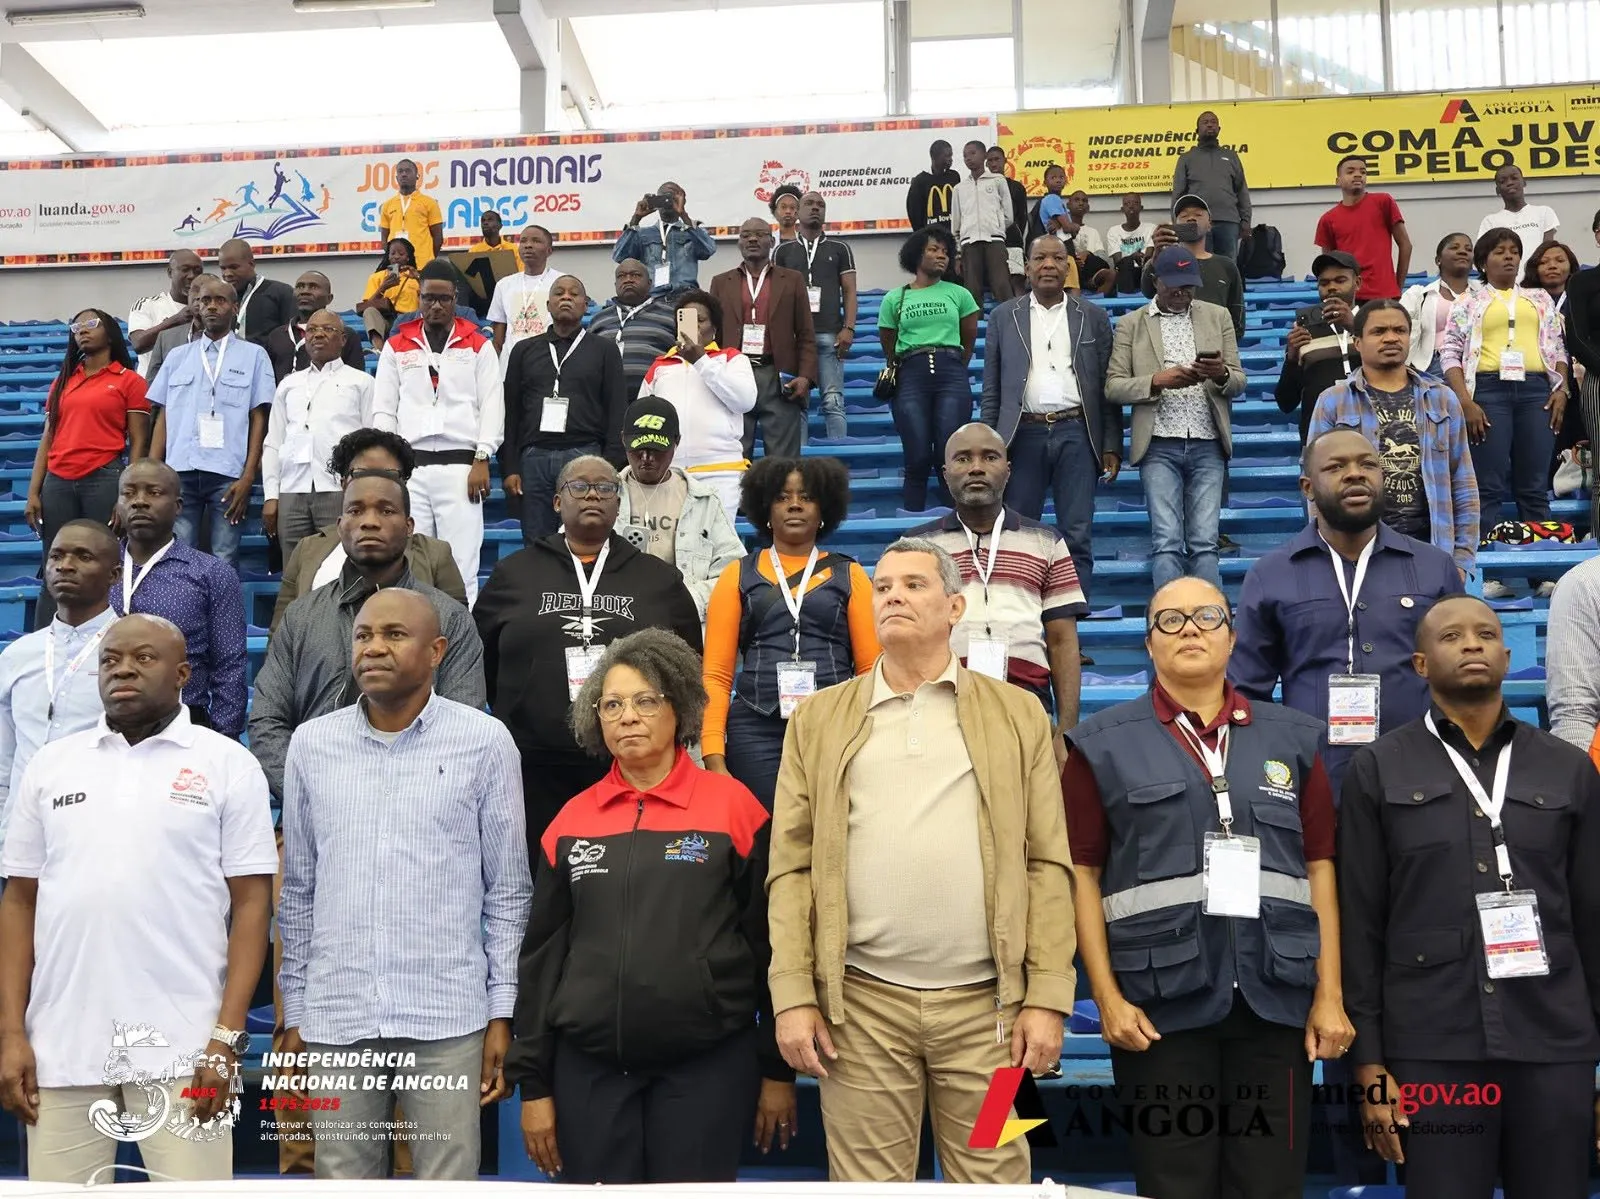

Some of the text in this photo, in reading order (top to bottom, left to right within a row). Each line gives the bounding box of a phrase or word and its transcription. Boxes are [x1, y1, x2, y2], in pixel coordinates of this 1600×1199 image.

[1482, 104, 1556, 116] ANGOLA
[1087, 130, 1199, 146] INDEPENDÊNCI
[1327, 128, 1437, 154] COM
[1452, 127, 1484, 150] A
[1088, 146, 1163, 160] NACIONAL
[1166, 145, 1186, 157] DE
[1024, 159, 1055, 168] ANOS
[1087, 161, 1151, 172] 1975-2025
[1395, 148, 1515, 176] PELO
[1530, 145, 1600, 170] DE
[449, 153, 603, 188] NACIONAIS
[818, 166, 892, 178] INDEPENDÊNCIA
[818, 179, 864, 188] NACIONAL
[865, 178, 878, 187] DE
[39, 202, 136, 218] luanda.gov.ao
[533, 193, 581, 212] 2025
[904, 307, 949, 320] YOURSELF
[905, 301, 946, 313] REFRESH
[52, 792, 88, 811] MED
